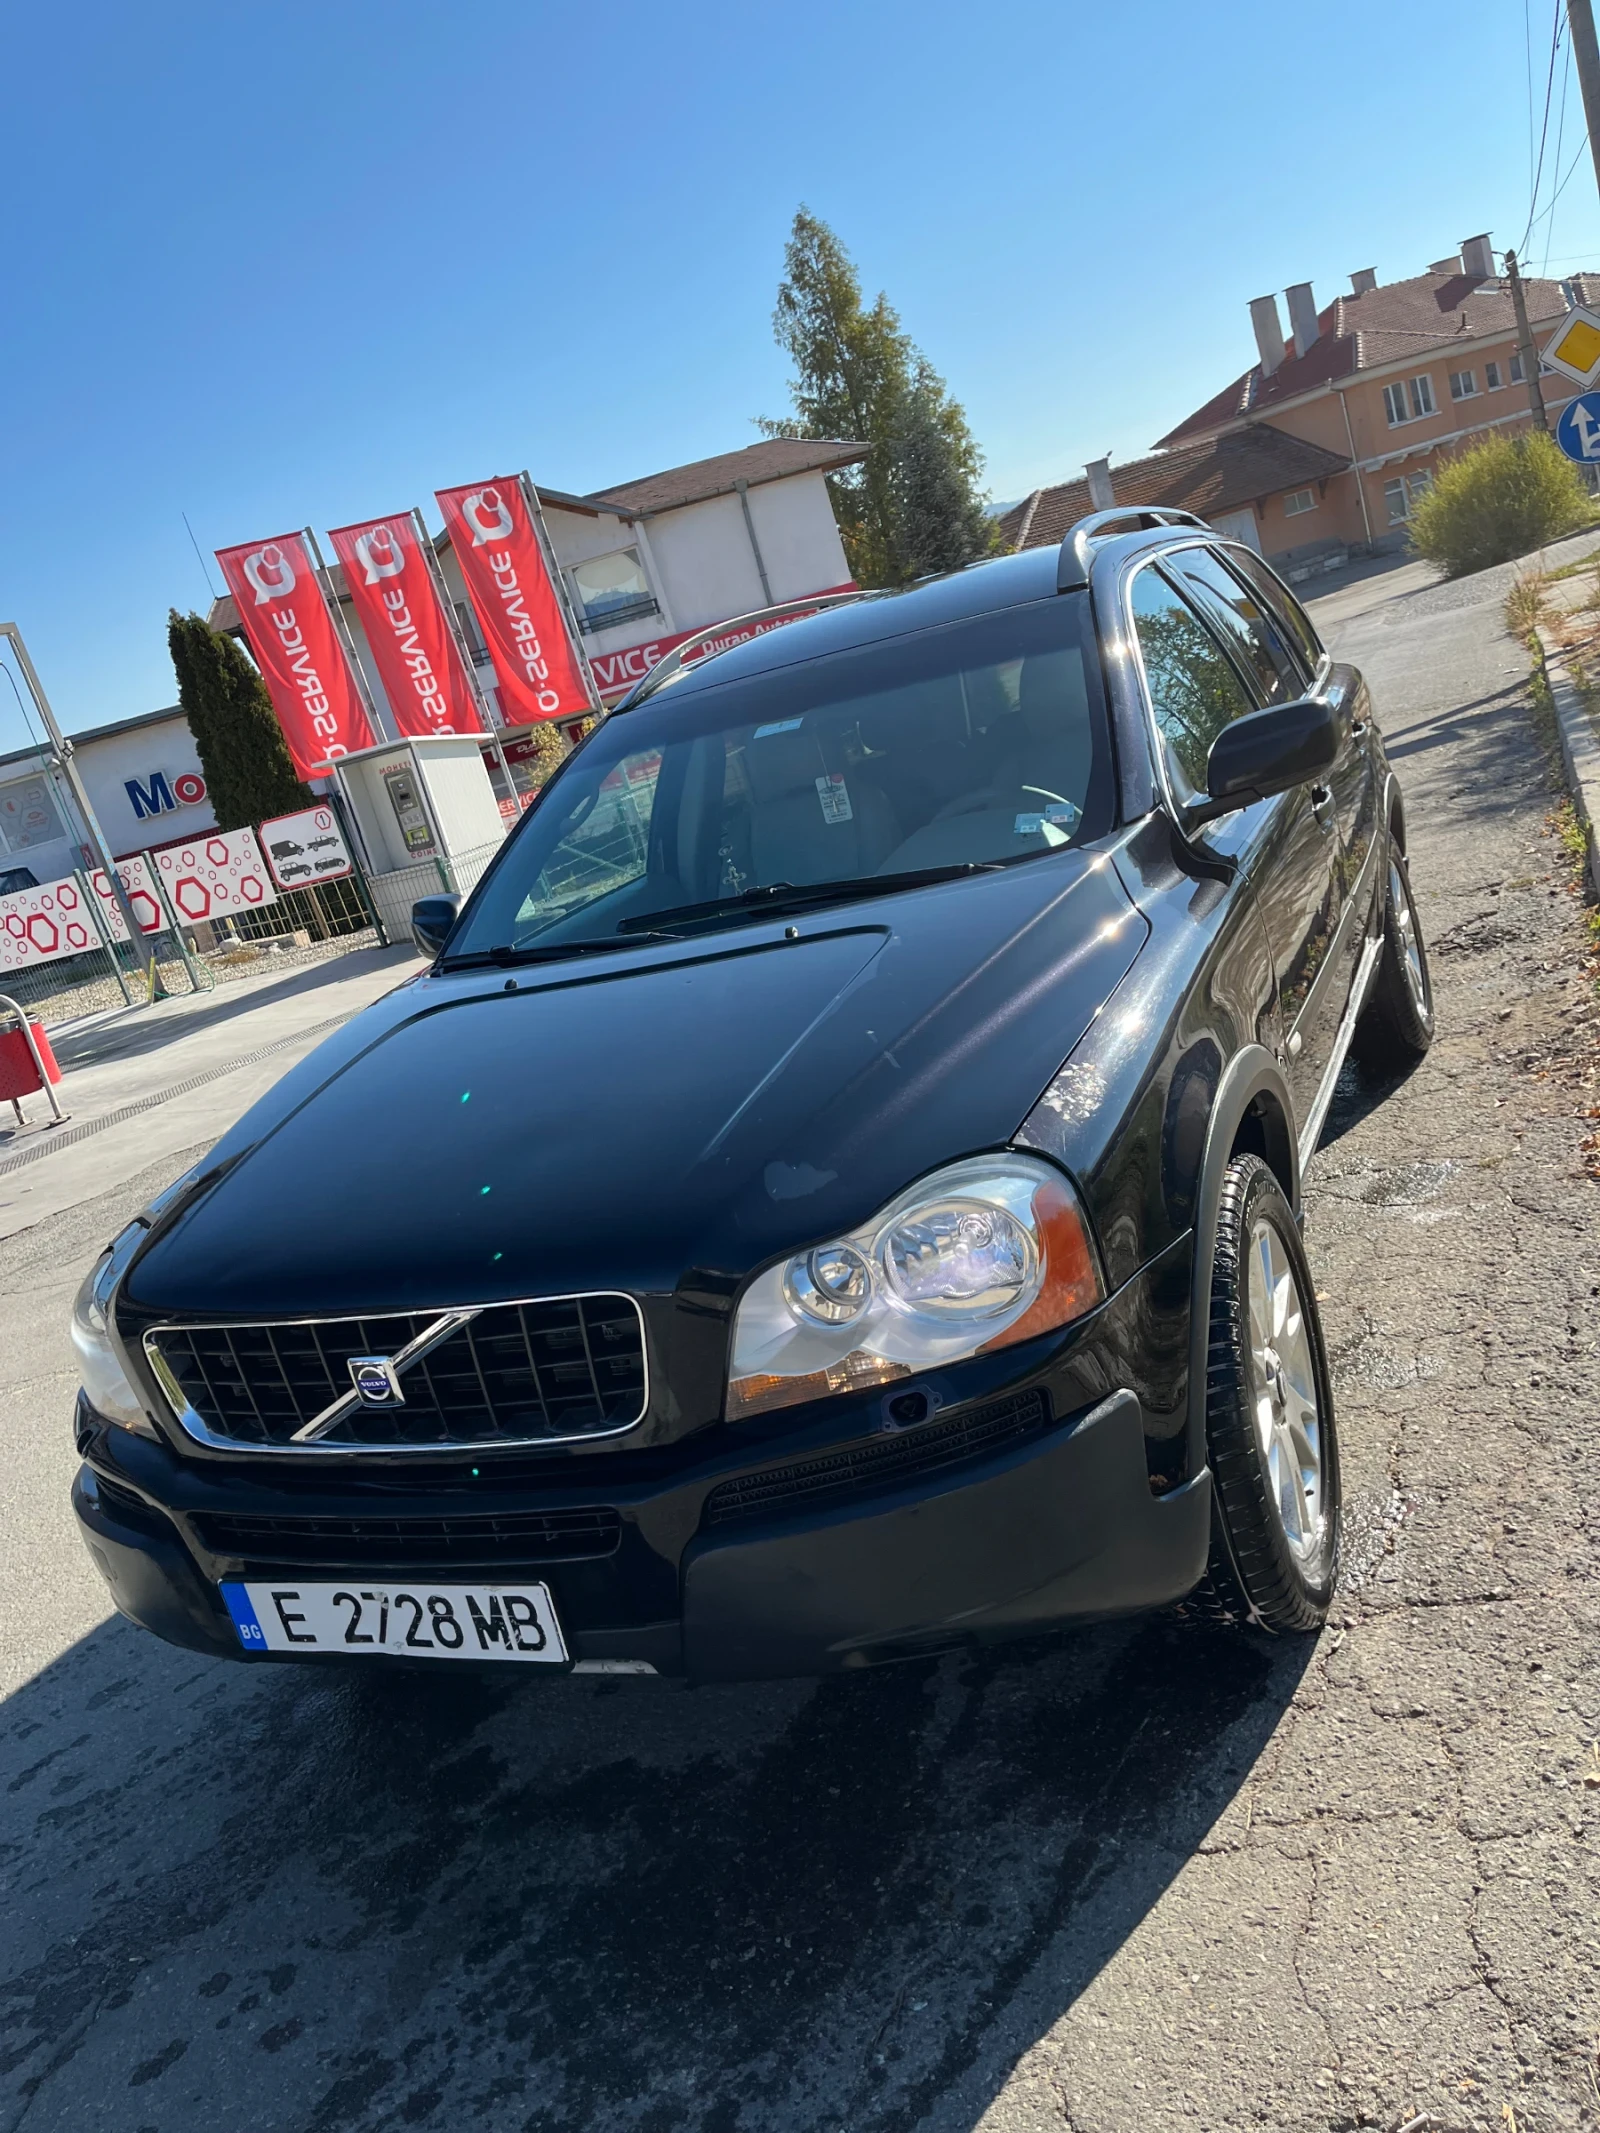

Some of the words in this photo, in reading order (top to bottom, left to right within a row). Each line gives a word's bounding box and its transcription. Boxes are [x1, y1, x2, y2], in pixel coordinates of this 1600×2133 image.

[701, 631, 752, 656] Duran
[592, 644, 662, 685] VICE
[410, 847, 438, 860] COINS
[361, 1380, 387, 1388] VOLVO
[271, 1591, 318, 1643] E
[332, 1591, 465, 1649] 2728
[465, 1595, 547, 1652] MB
[239, 1624, 262, 1640] BG
